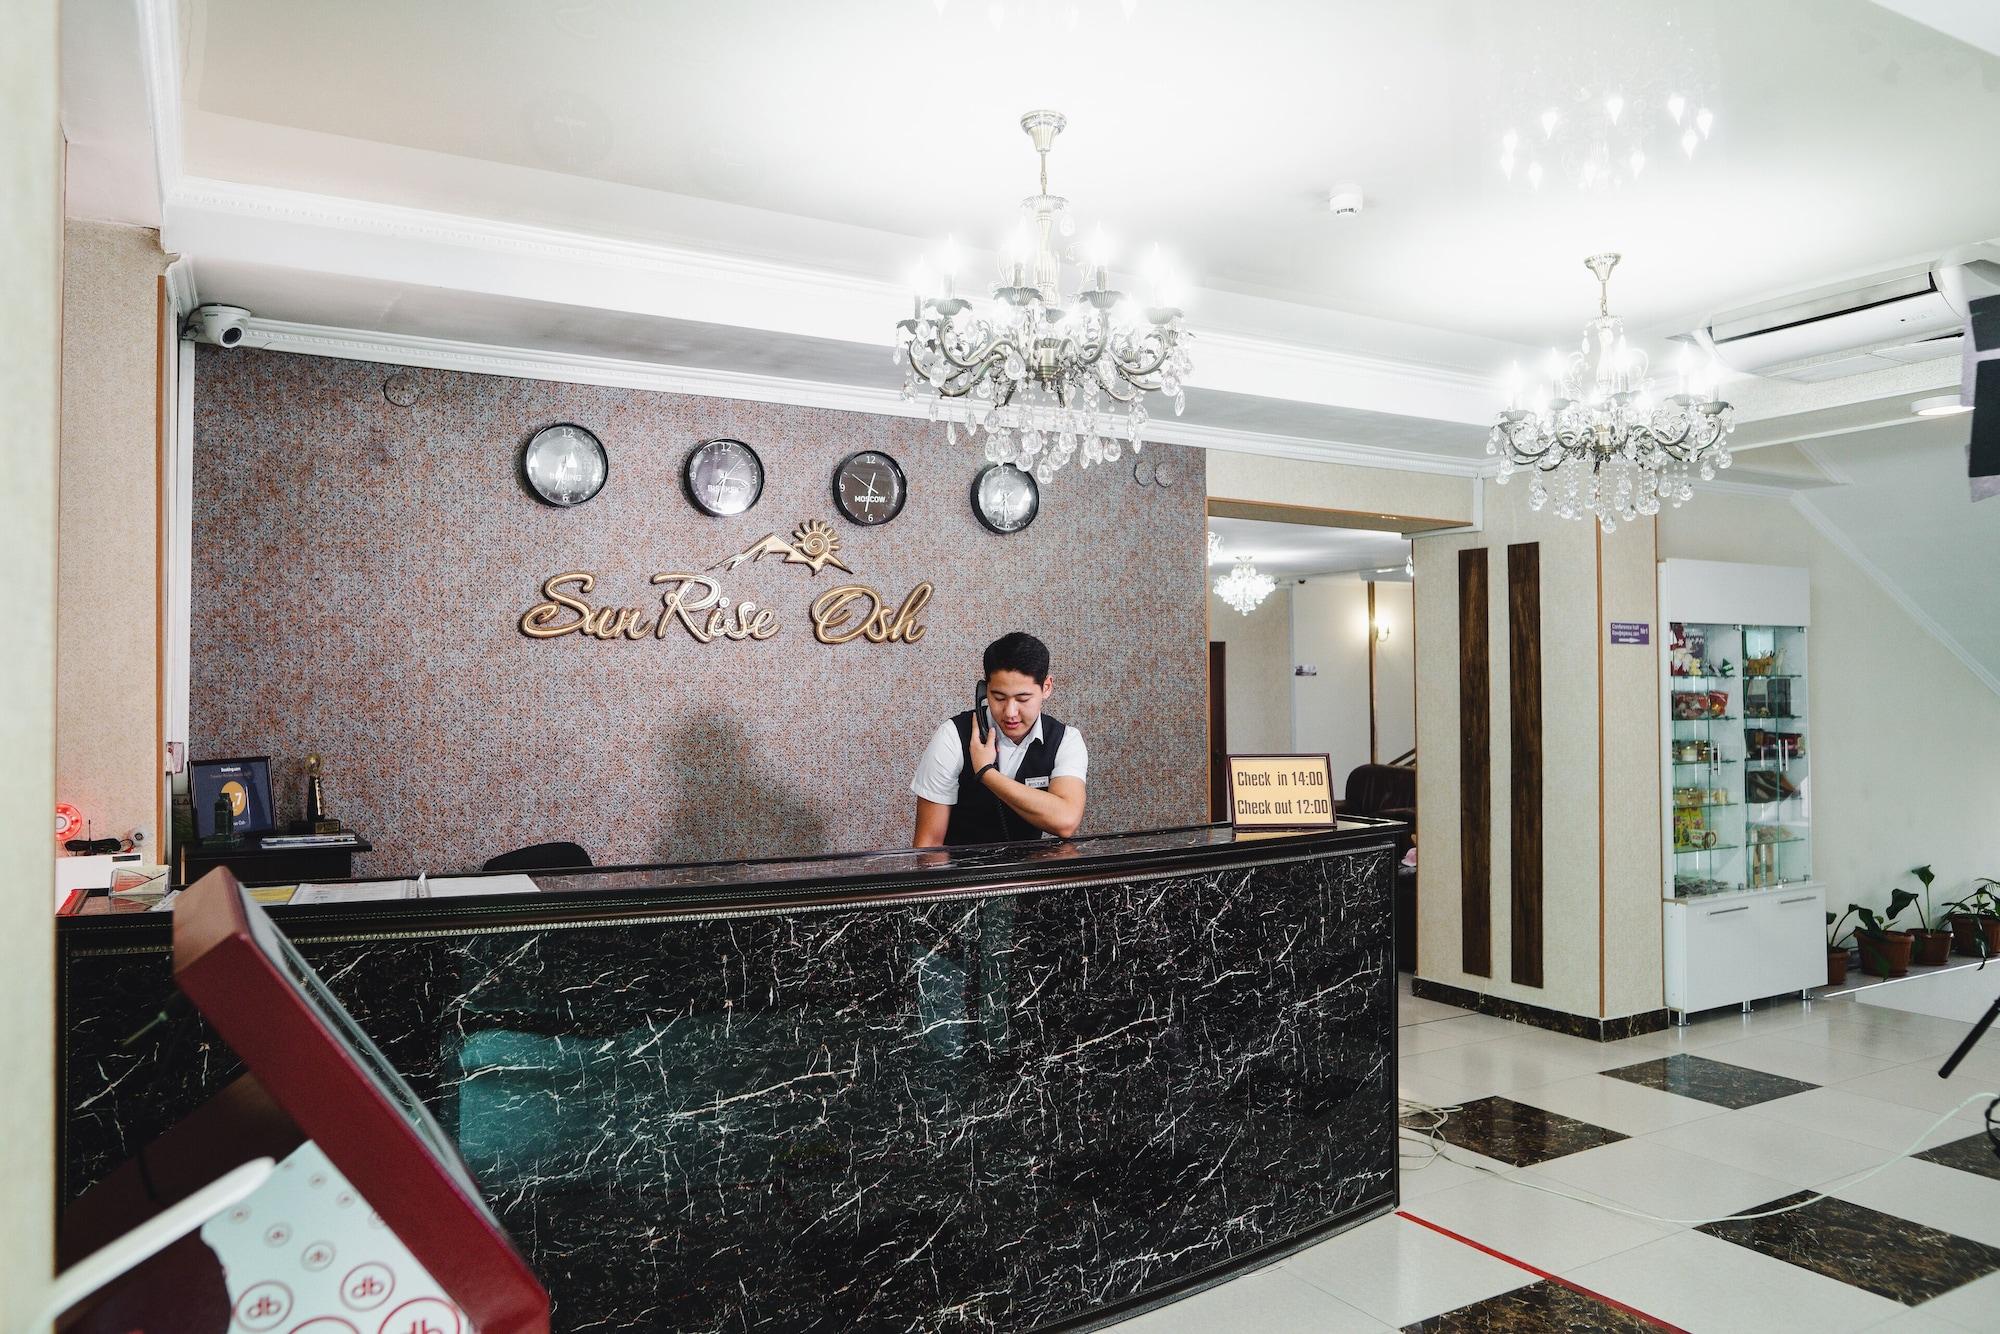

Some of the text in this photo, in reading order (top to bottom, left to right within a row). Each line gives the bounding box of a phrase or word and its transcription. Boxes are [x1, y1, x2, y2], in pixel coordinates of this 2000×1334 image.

[866, 455, 876, 464] 12
[854, 495, 886, 504] MOSCOW
[809, 581, 935, 644] Osh
[1237, 771, 1323, 786] Check in 14:00
[1237, 800, 1329, 814] Check out 12:00
